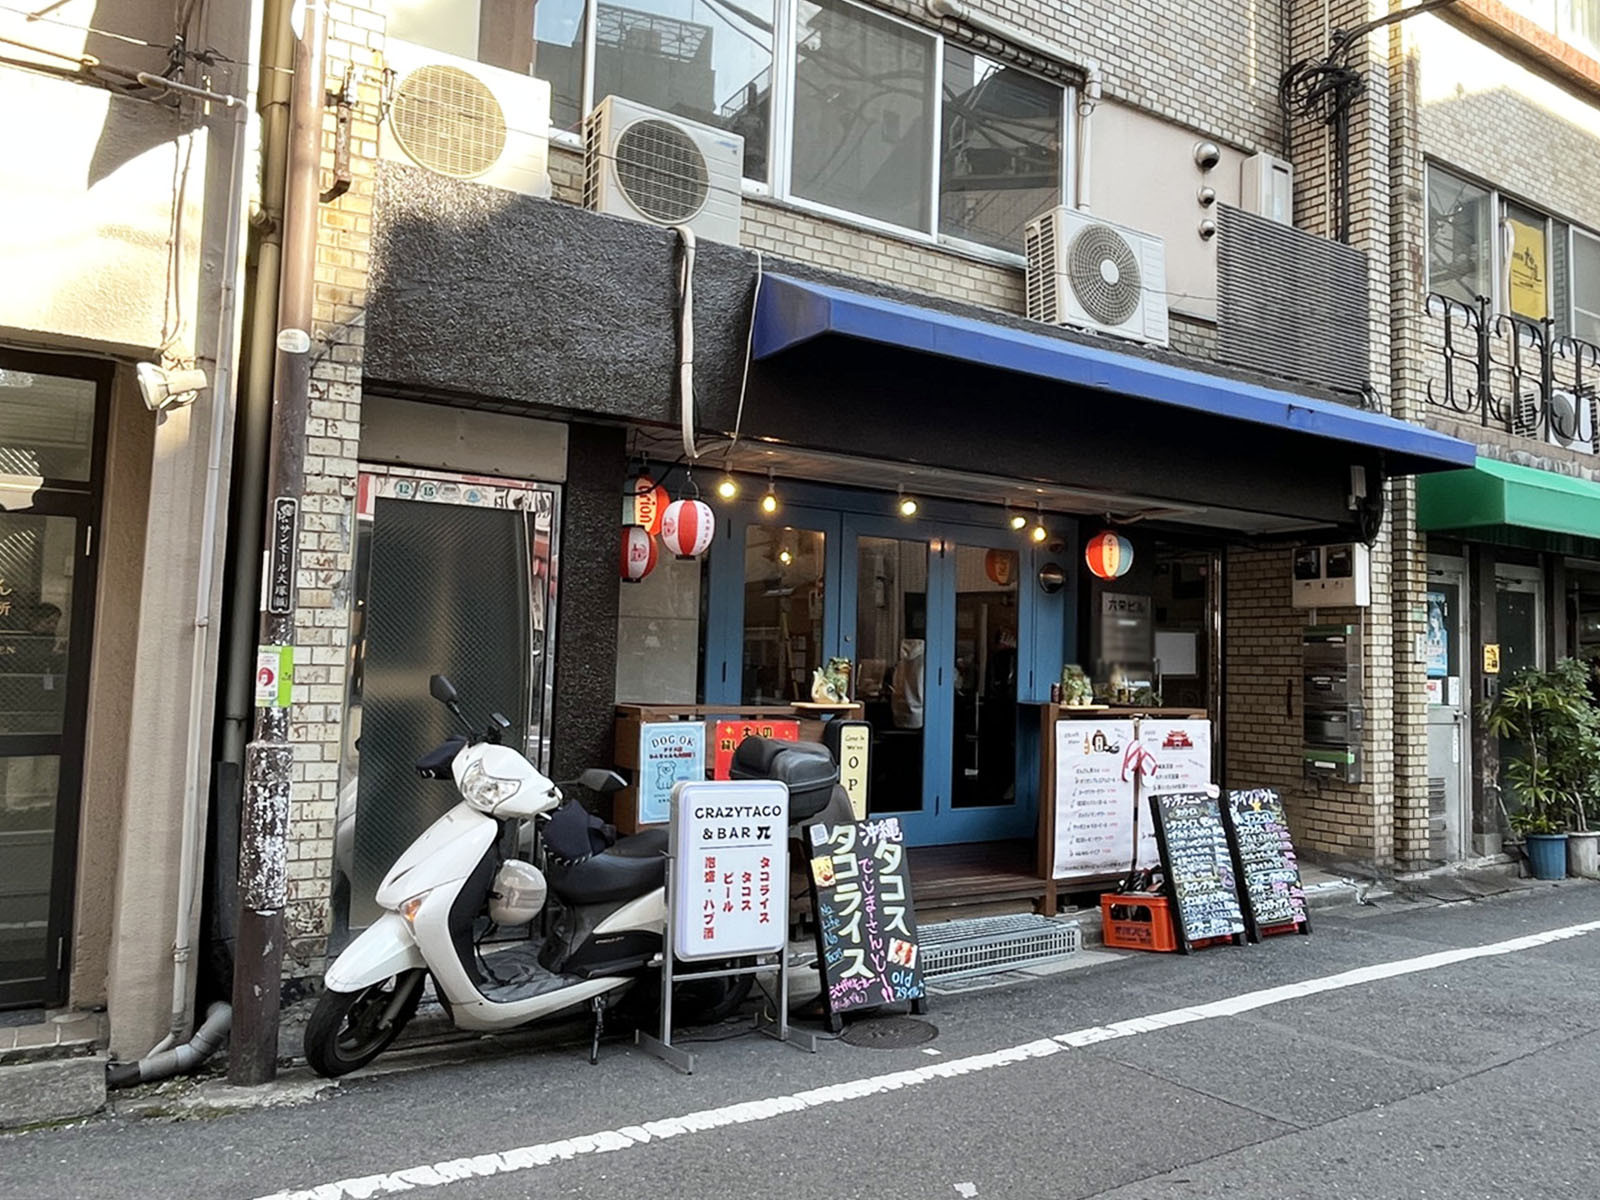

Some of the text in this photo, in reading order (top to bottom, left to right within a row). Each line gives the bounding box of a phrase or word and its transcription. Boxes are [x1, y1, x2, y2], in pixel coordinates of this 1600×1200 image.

[399, 484, 410, 494] 12
[423, 486, 434, 496] 15
[651, 734, 695, 749] DOG OK
[694, 805, 782, 820] CRAZYTACO
[702, 829, 713, 840] &
[717, 827, 751, 840] BAR
[859, 817, 903, 846] 沖縄
[702, 856, 716, 940] 泡盛・ハブ酒
[722, 872, 734, 913] ビール
[741, 871, 752, 912] タコス
[759, 856, 770, 924] タコライス
[828, 825, 875, 978] タコライス
[874, 840, 911, 936] タコス
